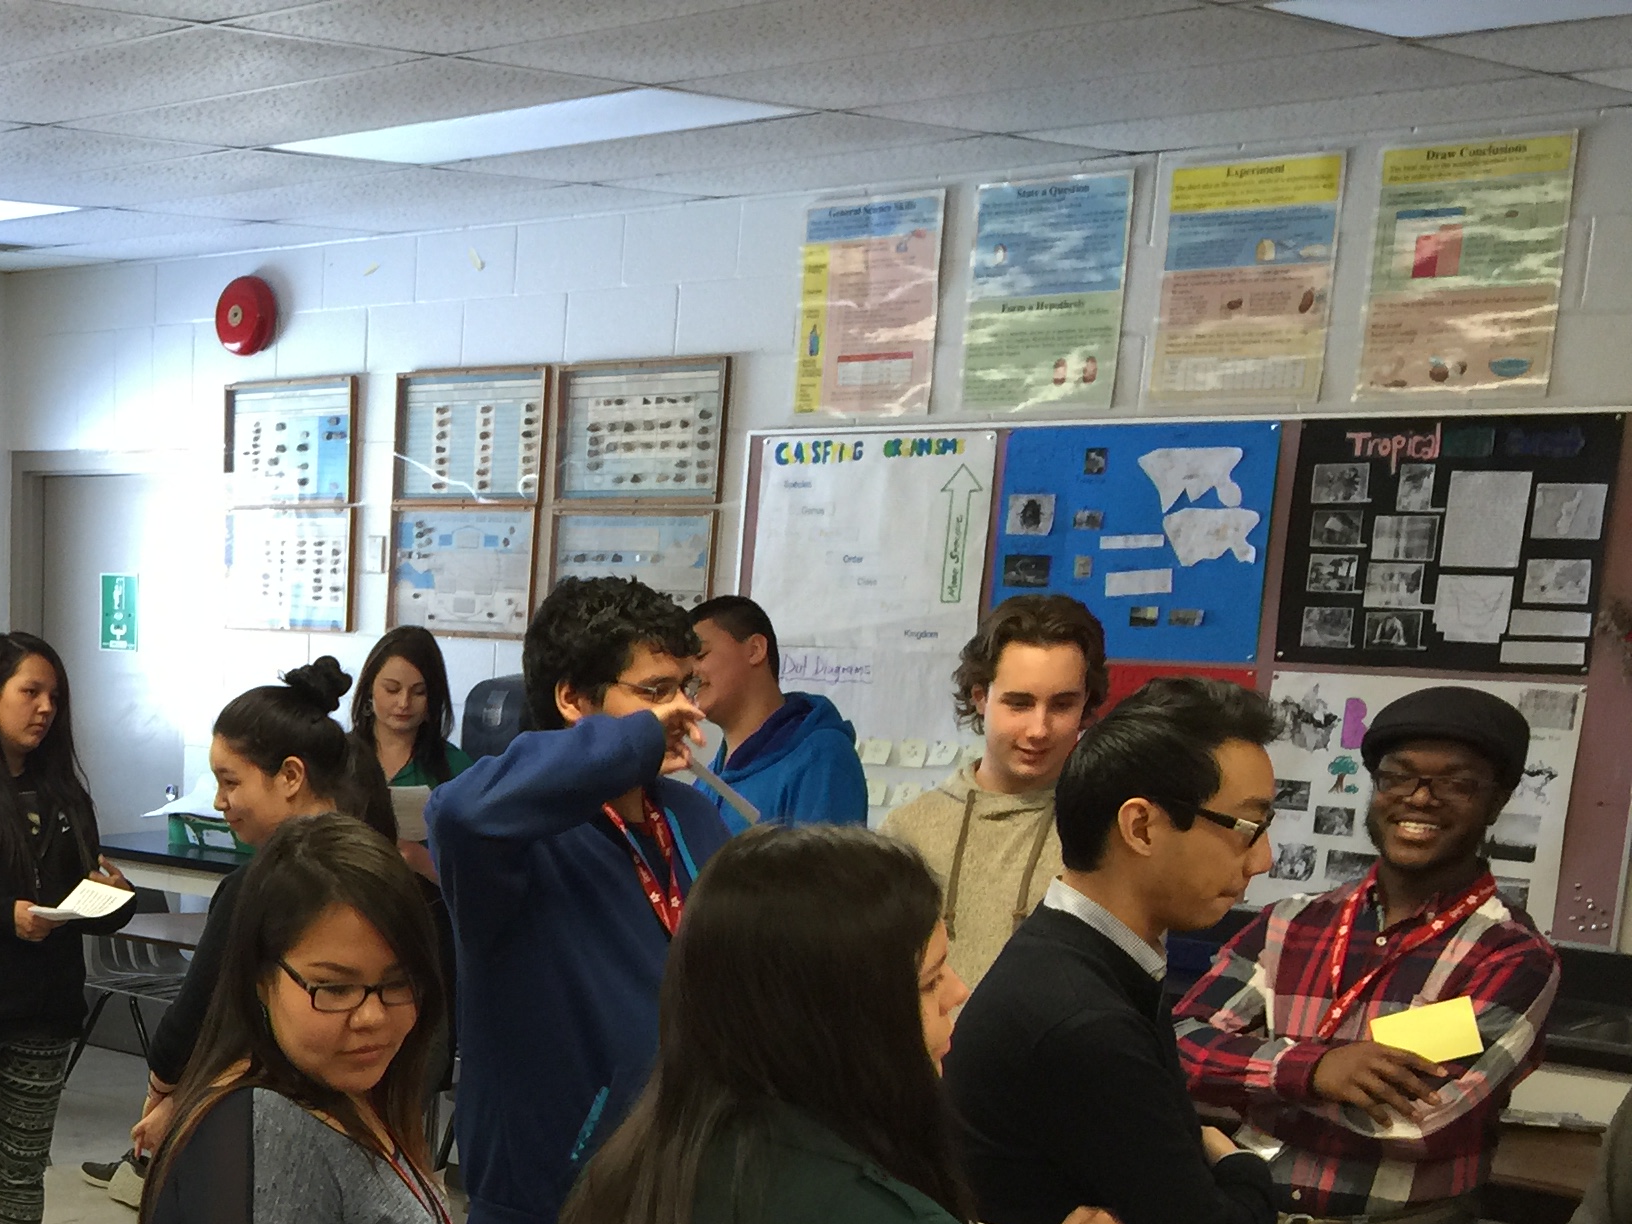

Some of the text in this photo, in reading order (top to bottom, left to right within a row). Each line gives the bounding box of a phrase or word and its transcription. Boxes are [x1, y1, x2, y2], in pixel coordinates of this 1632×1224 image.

[1426, 143, 1527, 161] Draw Conclusions
[1226, 164, 1285, 178] Experiment
[1017, 188, 1039, 199] State
[1049, 184, 1090, 197] Question
[1346, 422, 1442, 475] Tropical
[784, 480, 812, 489] Species
[843, 554, 864, 564] Order
[904, 629, 939, 640] Kingdom
